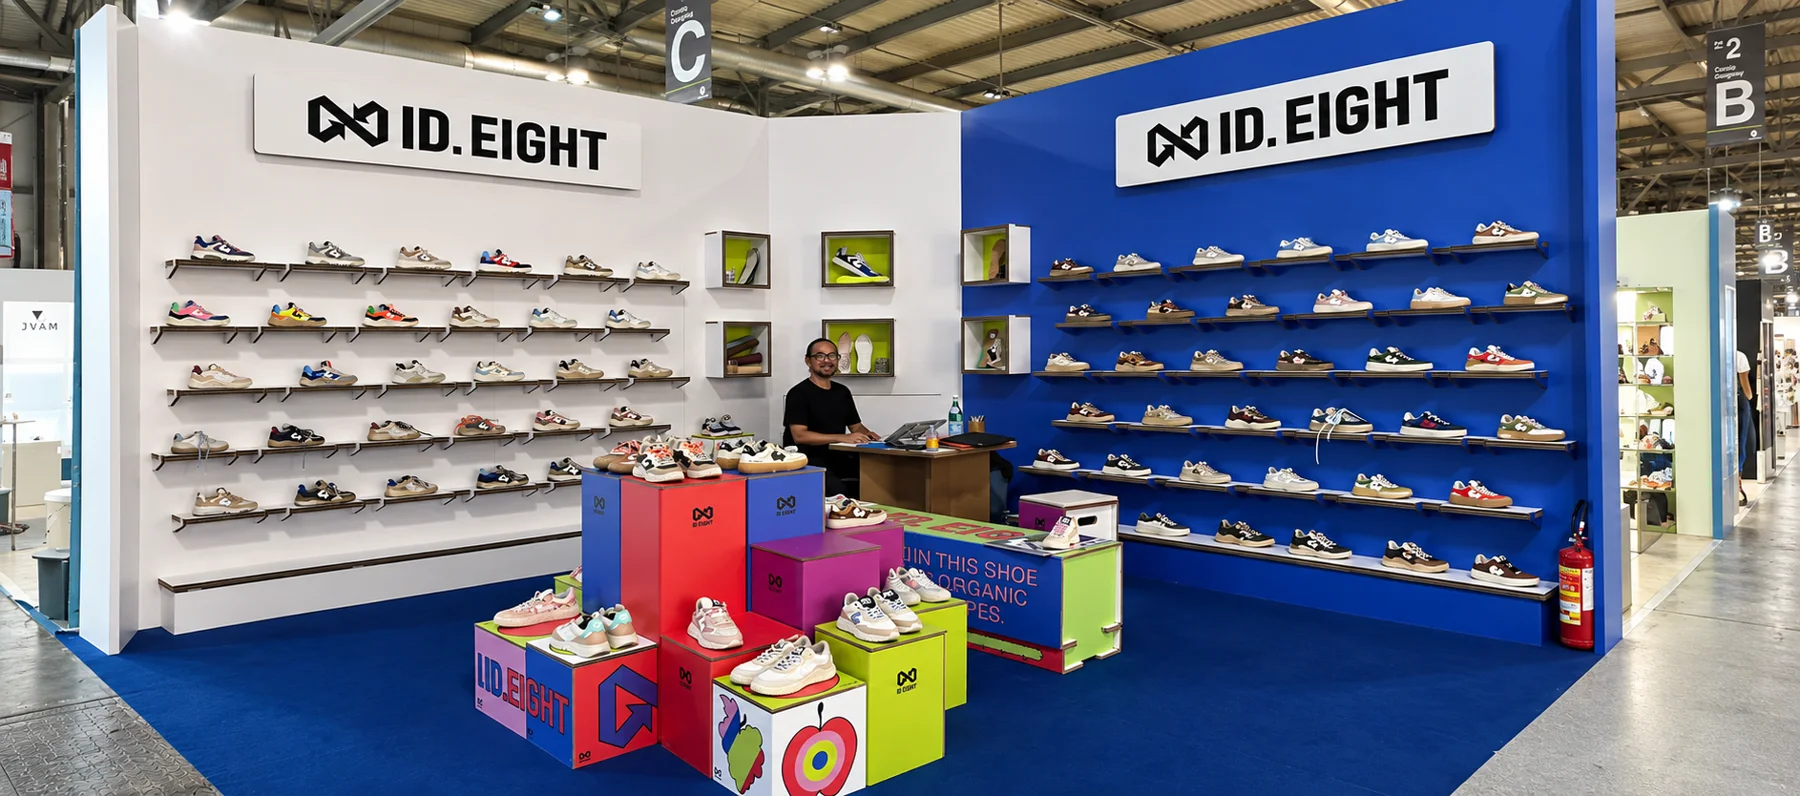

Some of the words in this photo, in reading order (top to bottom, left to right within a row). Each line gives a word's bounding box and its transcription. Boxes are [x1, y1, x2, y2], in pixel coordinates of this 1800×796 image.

[671, 20, 706, 83] C
[1726, 37, 1741, 60] 2
[1716, 79, 1755, 127] B
[21, 322, 58, 331] JVAM
[936, 551, 978, 575] THIS
[985, 561, 1038, 588] SHOE
[938, 573, 1028, 608] ORGANIC
[967, 600, 1005, 625] PES.
